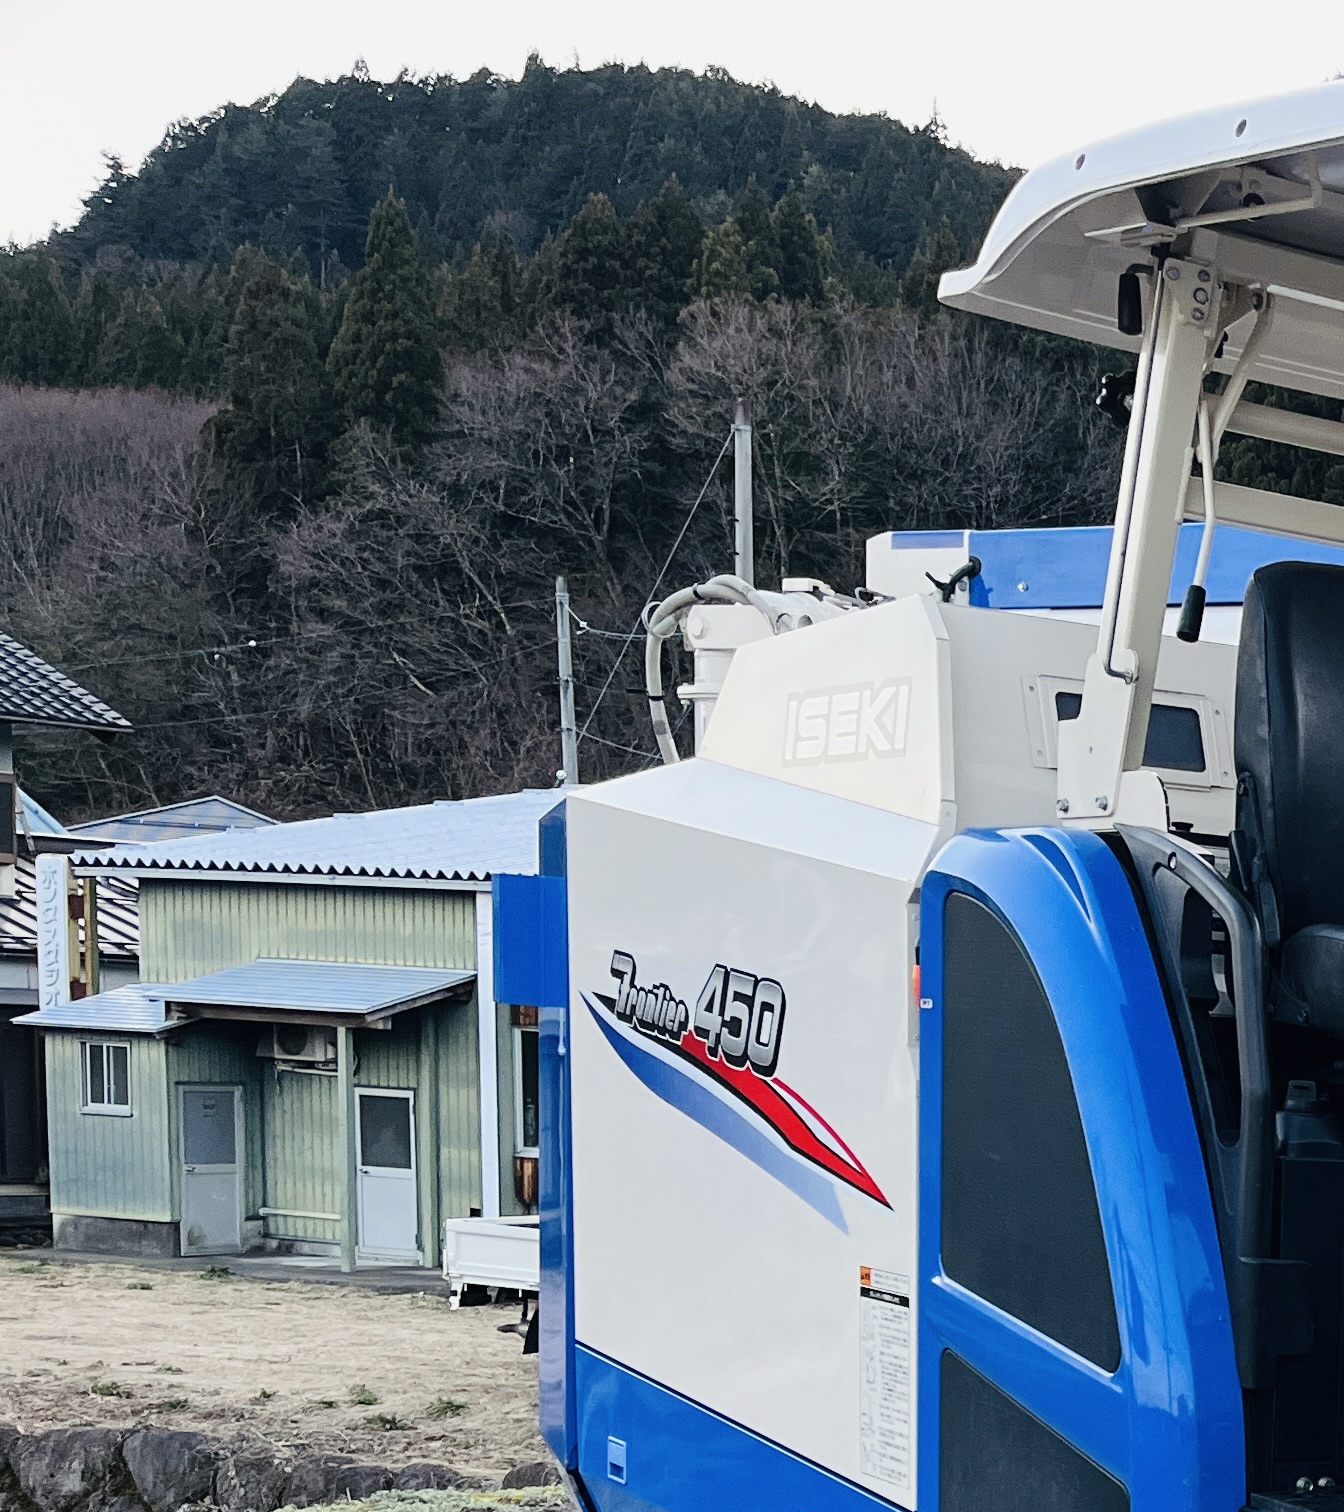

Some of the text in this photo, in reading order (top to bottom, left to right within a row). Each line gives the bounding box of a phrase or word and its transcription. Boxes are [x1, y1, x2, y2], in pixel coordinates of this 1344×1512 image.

[783, 680, 911, 764] ISEKI
[610, 950, 786, 1076] Frontier 450
